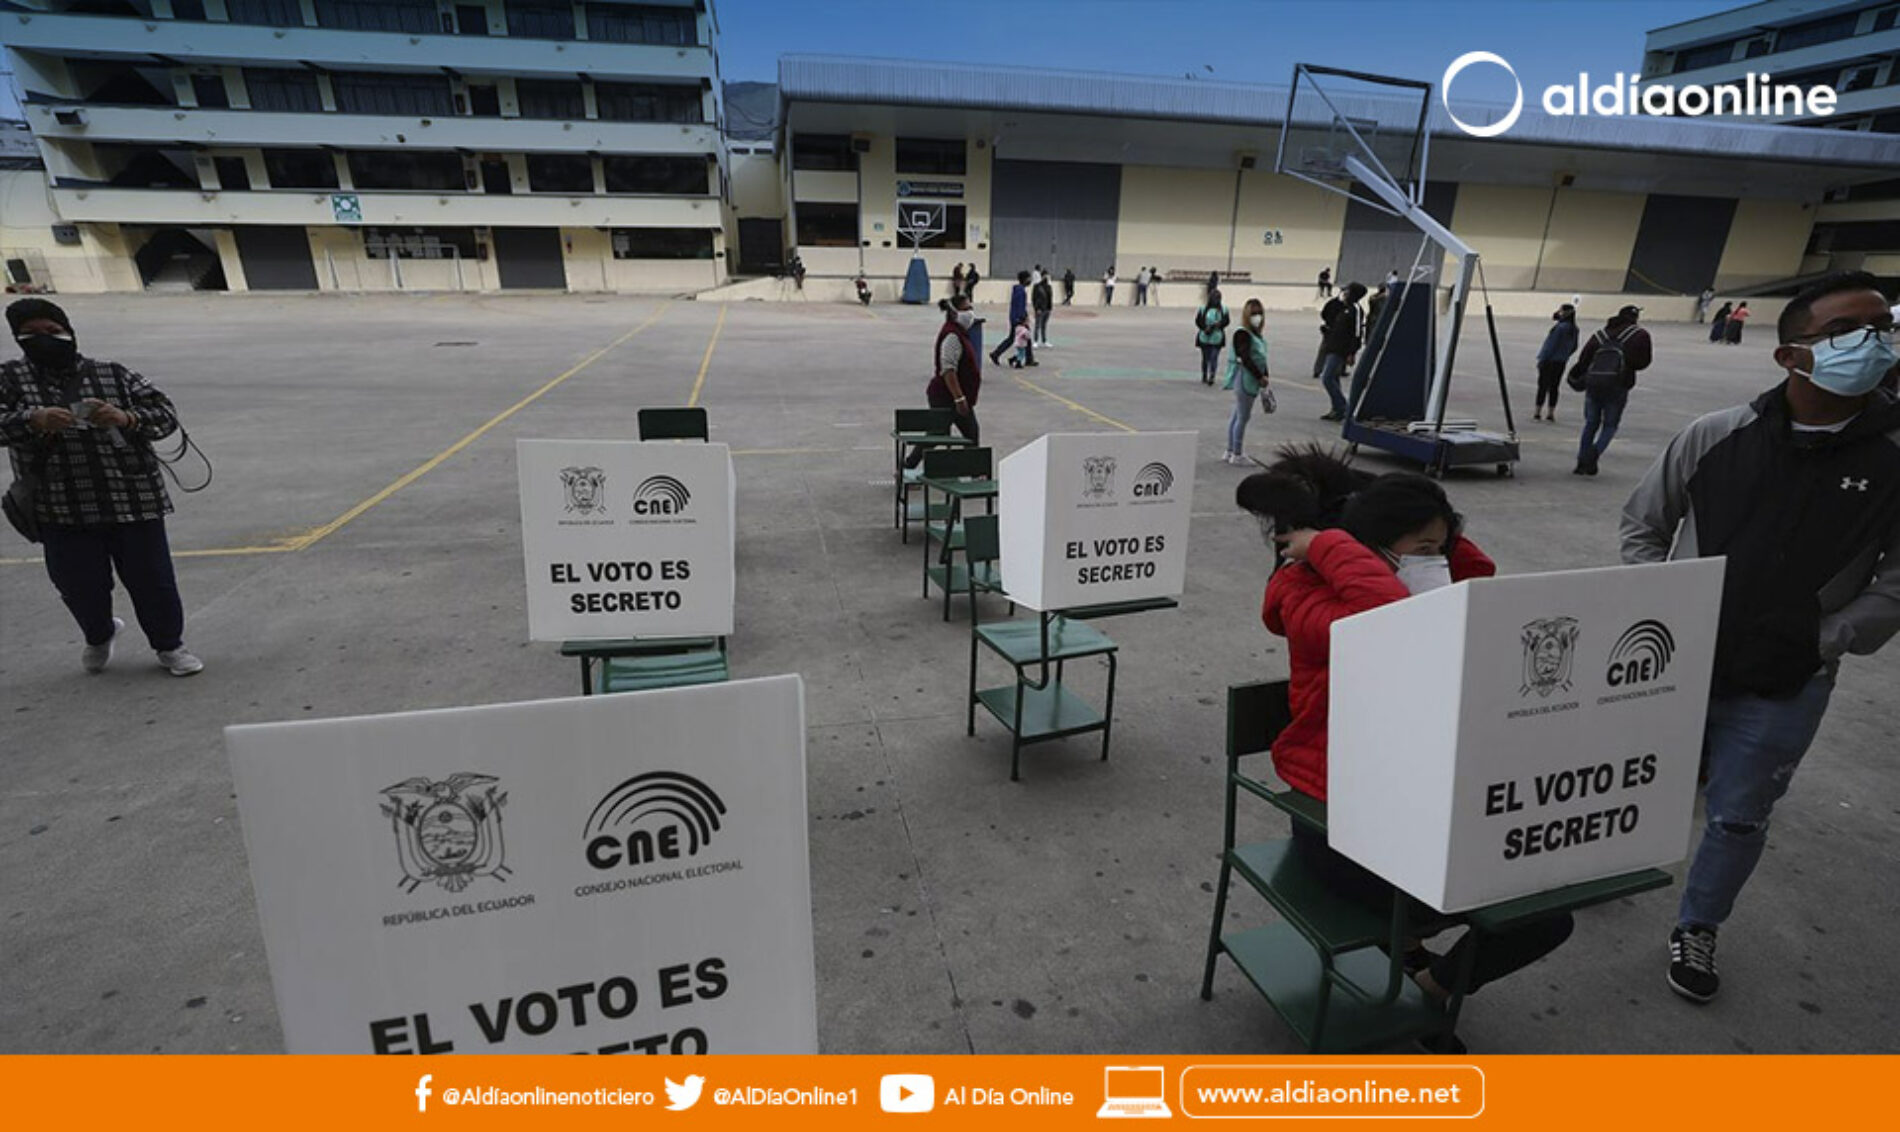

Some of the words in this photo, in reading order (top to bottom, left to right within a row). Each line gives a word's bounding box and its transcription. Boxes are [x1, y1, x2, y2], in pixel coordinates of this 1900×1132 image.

[1066, 541, 1088, 560] EL
[1094, 537, 1140, 557] VOTO
[1144, 535, 1165, 553] ES
[550, 563, 581, 584] EL
[587, 561, 653, 583] VOTO
[660, 559, 691, 581] ES
[1077, 562, 1156, 585] SECRETO
[570, 590, 682, 614] SECRETO
[1485, 780, 1524, 817] EL
[1534, 762, 1614, 808] VOTO
[1621, 753, 1657, 790] ES
[1503, 803, 1640, 861] SECRETO
[574, 878, 627, 898] CONSEJO
[628, 870, 684, 890] NACIONAL
[685, 860, 744, 881] ELECTORAL
[382, 907, 450, 928] REPÚBLICA
[453, 904, 475, 918] DEL
[477, 894, 536, 915] ECUADOR
[370, 1013, 454, 1054] EL
[469, 976, 639, 1044] VOTO
[658, 957, 729, 1009] ES
